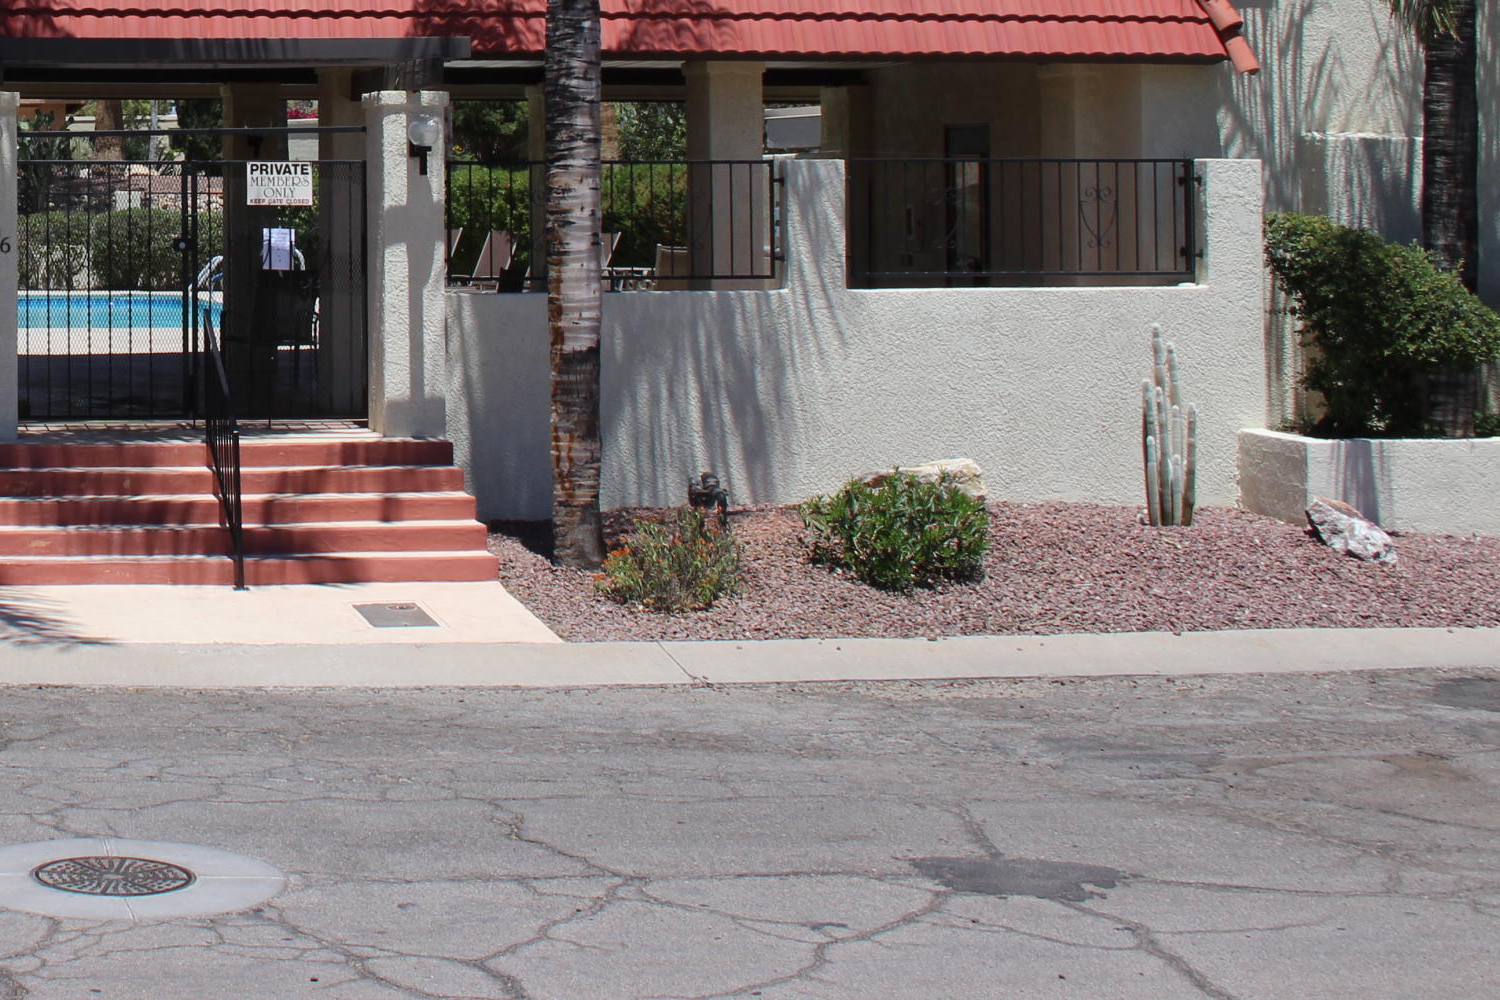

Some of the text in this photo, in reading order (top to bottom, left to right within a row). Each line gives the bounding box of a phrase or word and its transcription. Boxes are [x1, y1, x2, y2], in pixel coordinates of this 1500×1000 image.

[250, 164, 309, 175] PRIVATE
[250, 176, 309, 187] MEMBERS
[263, 187, 296, 198] ONLY
